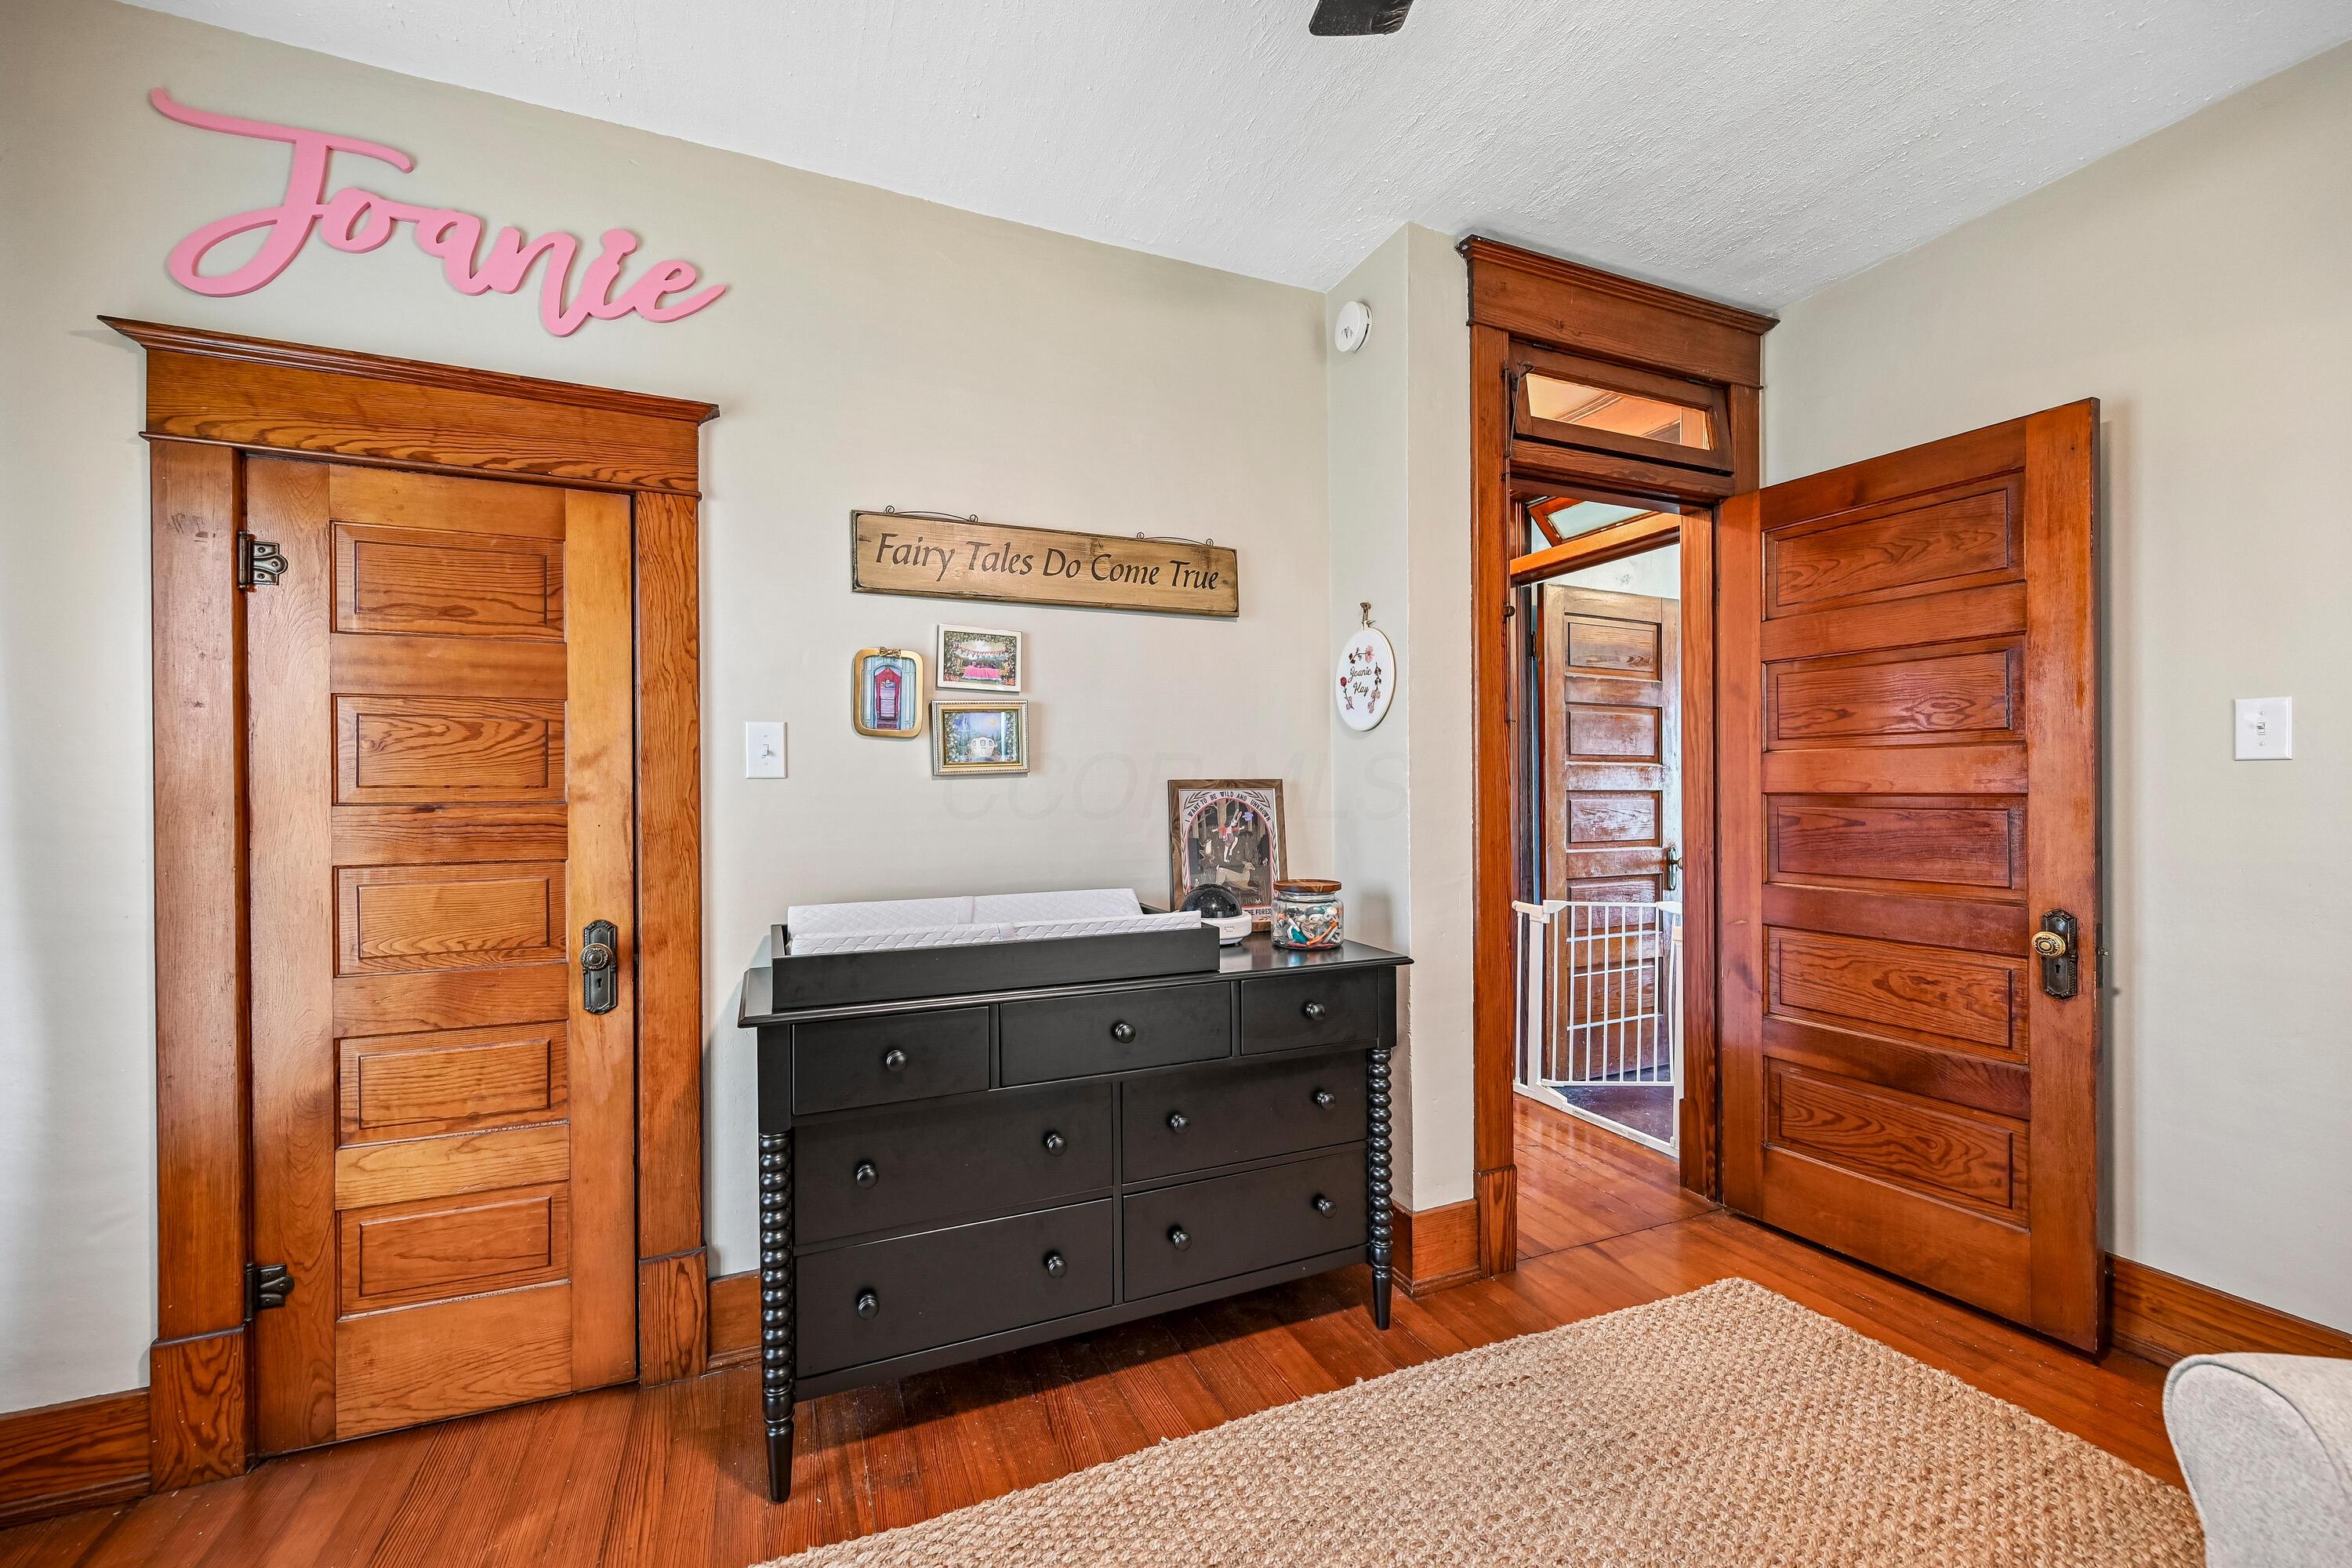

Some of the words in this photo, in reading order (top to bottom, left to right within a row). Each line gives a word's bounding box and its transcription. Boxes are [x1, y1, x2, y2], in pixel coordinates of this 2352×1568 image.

[151, 87, 727, 337] Joanie
[876, 532, 956, 582] Fairy
[965, 540, 1034, 576] Tales
[1042, 547, 1081, 579] Do
[1091, 553, 1160, 586] Come
[1169, 560, 1220, 590] True
[1348, 666, 1372, 683] Joanie
[1353, 681, 1370, 697] Kay
[1187, 803, 1202, 817] WANT
[1236, 793, 1247, 801] AND
[1250, 799, 1272, 822] UNKNOWN
